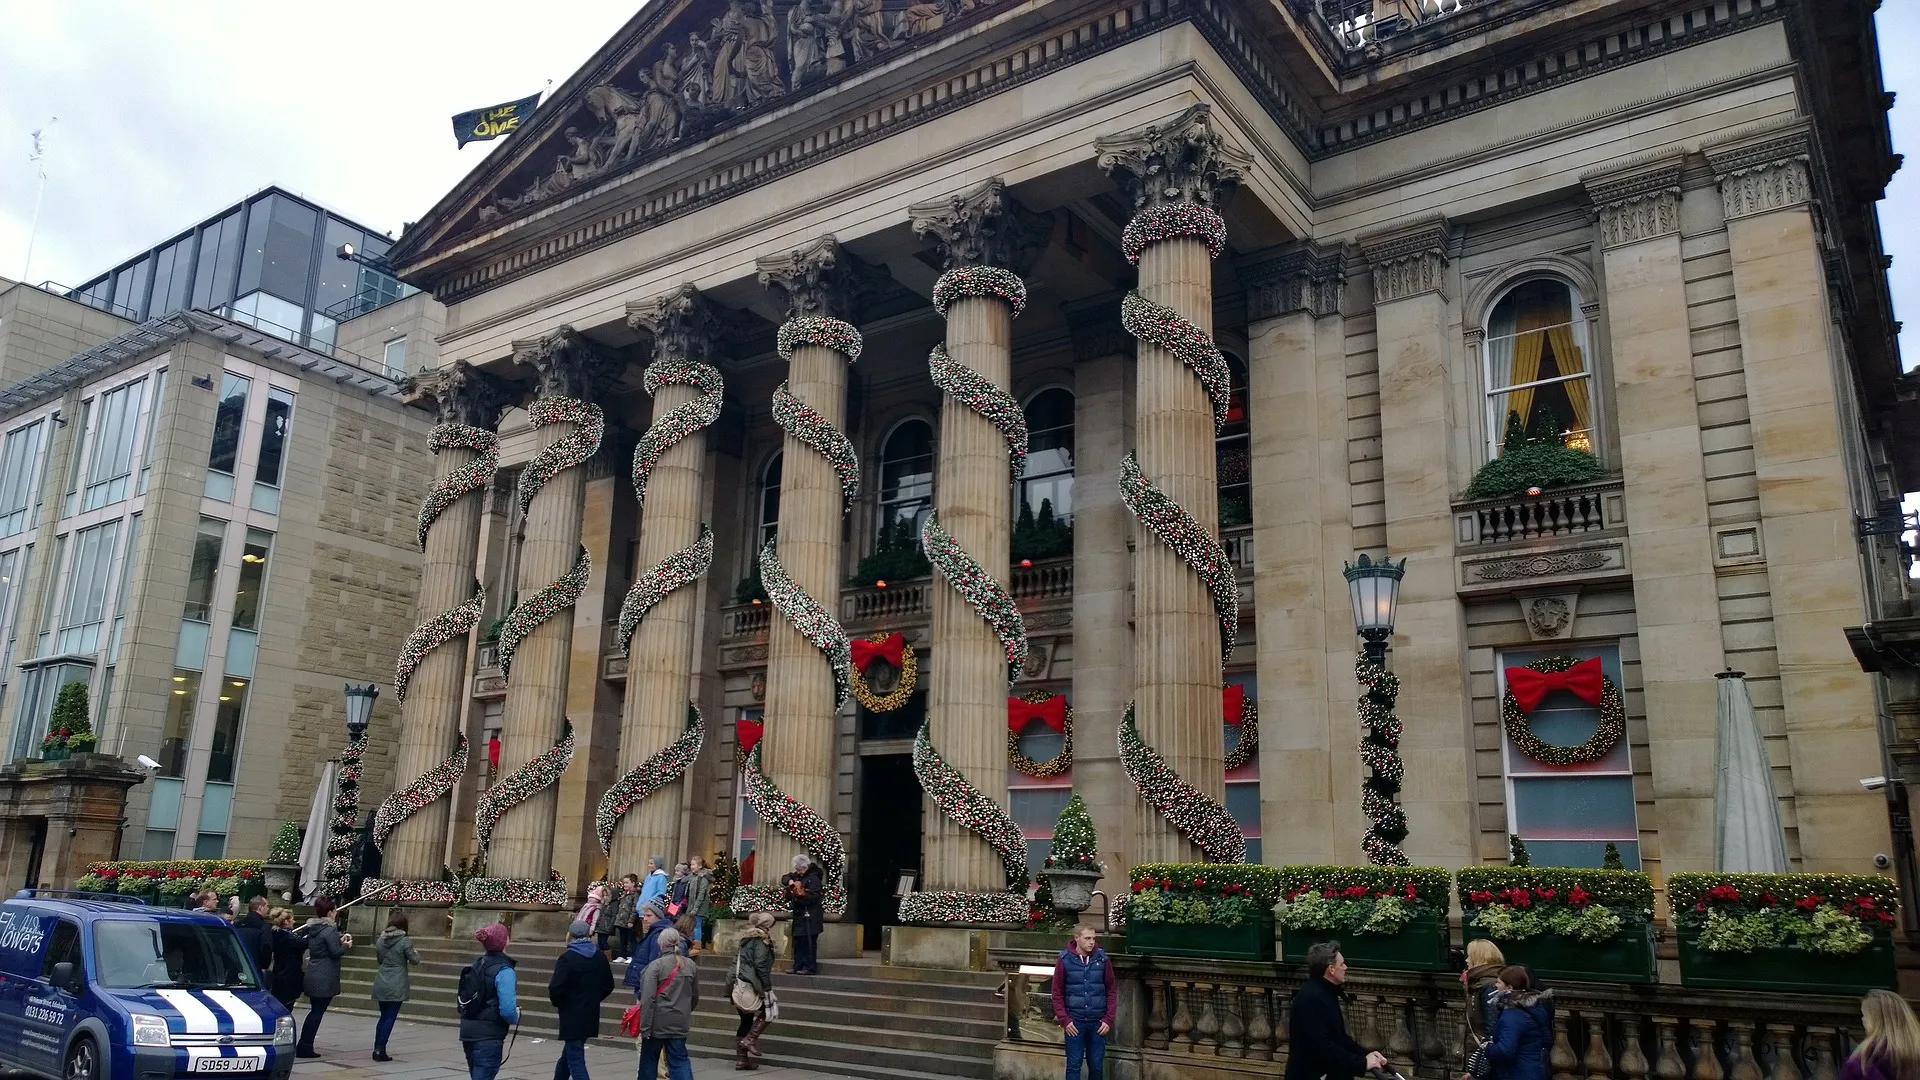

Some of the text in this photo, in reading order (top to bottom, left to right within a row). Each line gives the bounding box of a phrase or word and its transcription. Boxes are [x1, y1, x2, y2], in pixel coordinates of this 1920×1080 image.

[481, 105, 517, 122] THE
[25, 1005, 64, 1025] 0131 226 59 72
[201, 1060, 253, 1070] SD59 JJX
